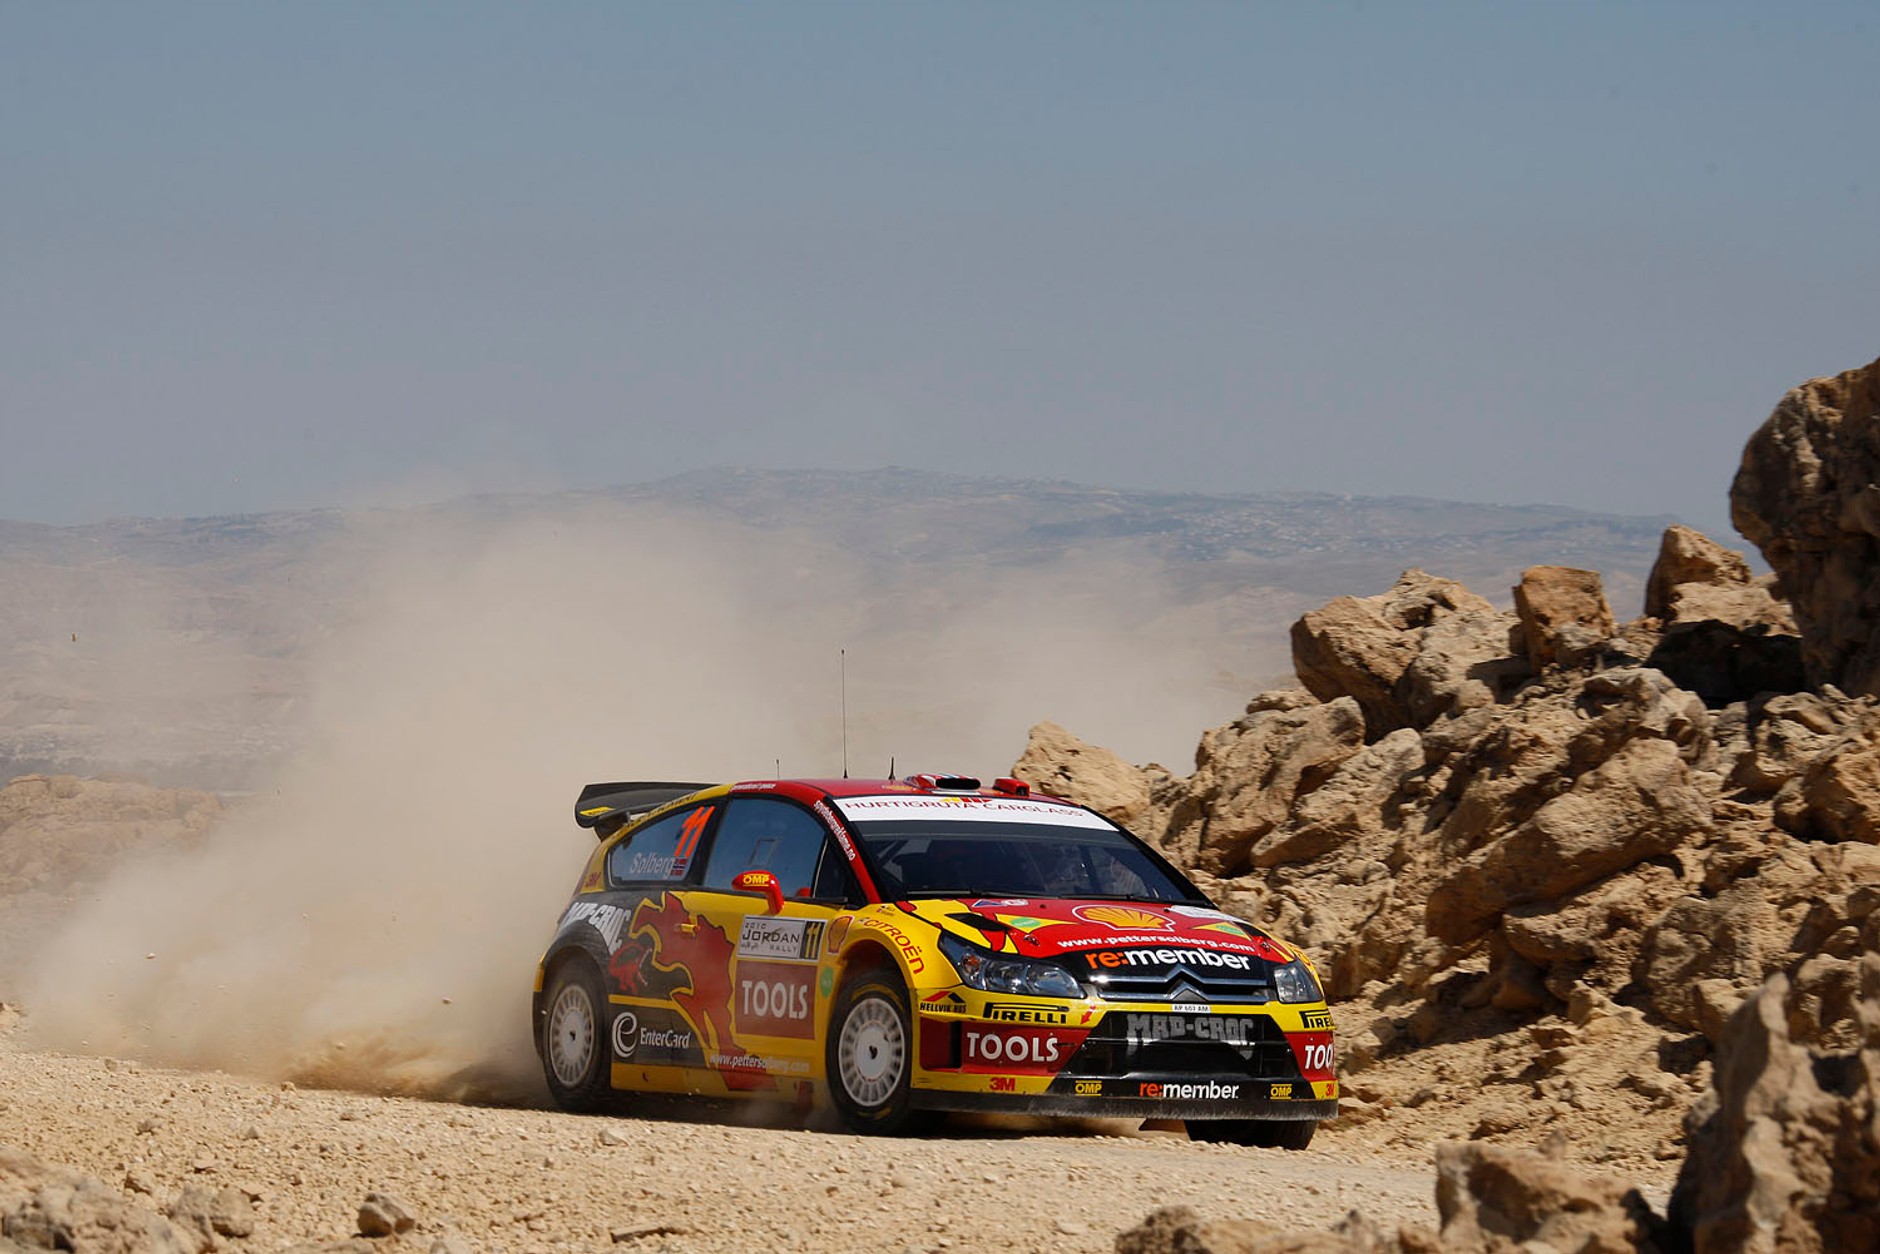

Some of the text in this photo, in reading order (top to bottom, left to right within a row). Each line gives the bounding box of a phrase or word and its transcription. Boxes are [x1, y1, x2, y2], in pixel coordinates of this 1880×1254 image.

[983, 802, 1083, 817] CARGLASS
[674, 806, 716, 857] 11
[630, 852, 677, 880] Solberg
[743, 874, 770, 885] OMP
[745, 922, 767, 930] 2010
[742, 929, 800, 944] JORDAN
[803, 922, 822, 959] 11
[1058, 934, 1255, 953] www.pettersolberg.com
[770, 944, 797, 953] RALLY
[864, 920, 925, 975] CITROËN
[1085, 948, 1251, 970] re:member
[742, 980, 809, 1020] TOOLS
[920, 1002, 952, 1013] HELLVIK
[983, 1002, 1070, 1024] PIRELLI
[640, 1028, 691, 1049] EnterCard
[1126, 1013, 1255, 1054] MAD-CROC
[966, 1032, 1059, 1062] TOOLS
[989, 1077, 1016, 1092] 3M
[1075, 1081, 1102, 1095] OMP
[1139, 1080, 1239, 1099] re:member
[1270, 1085, 1293, 1098] OMP
